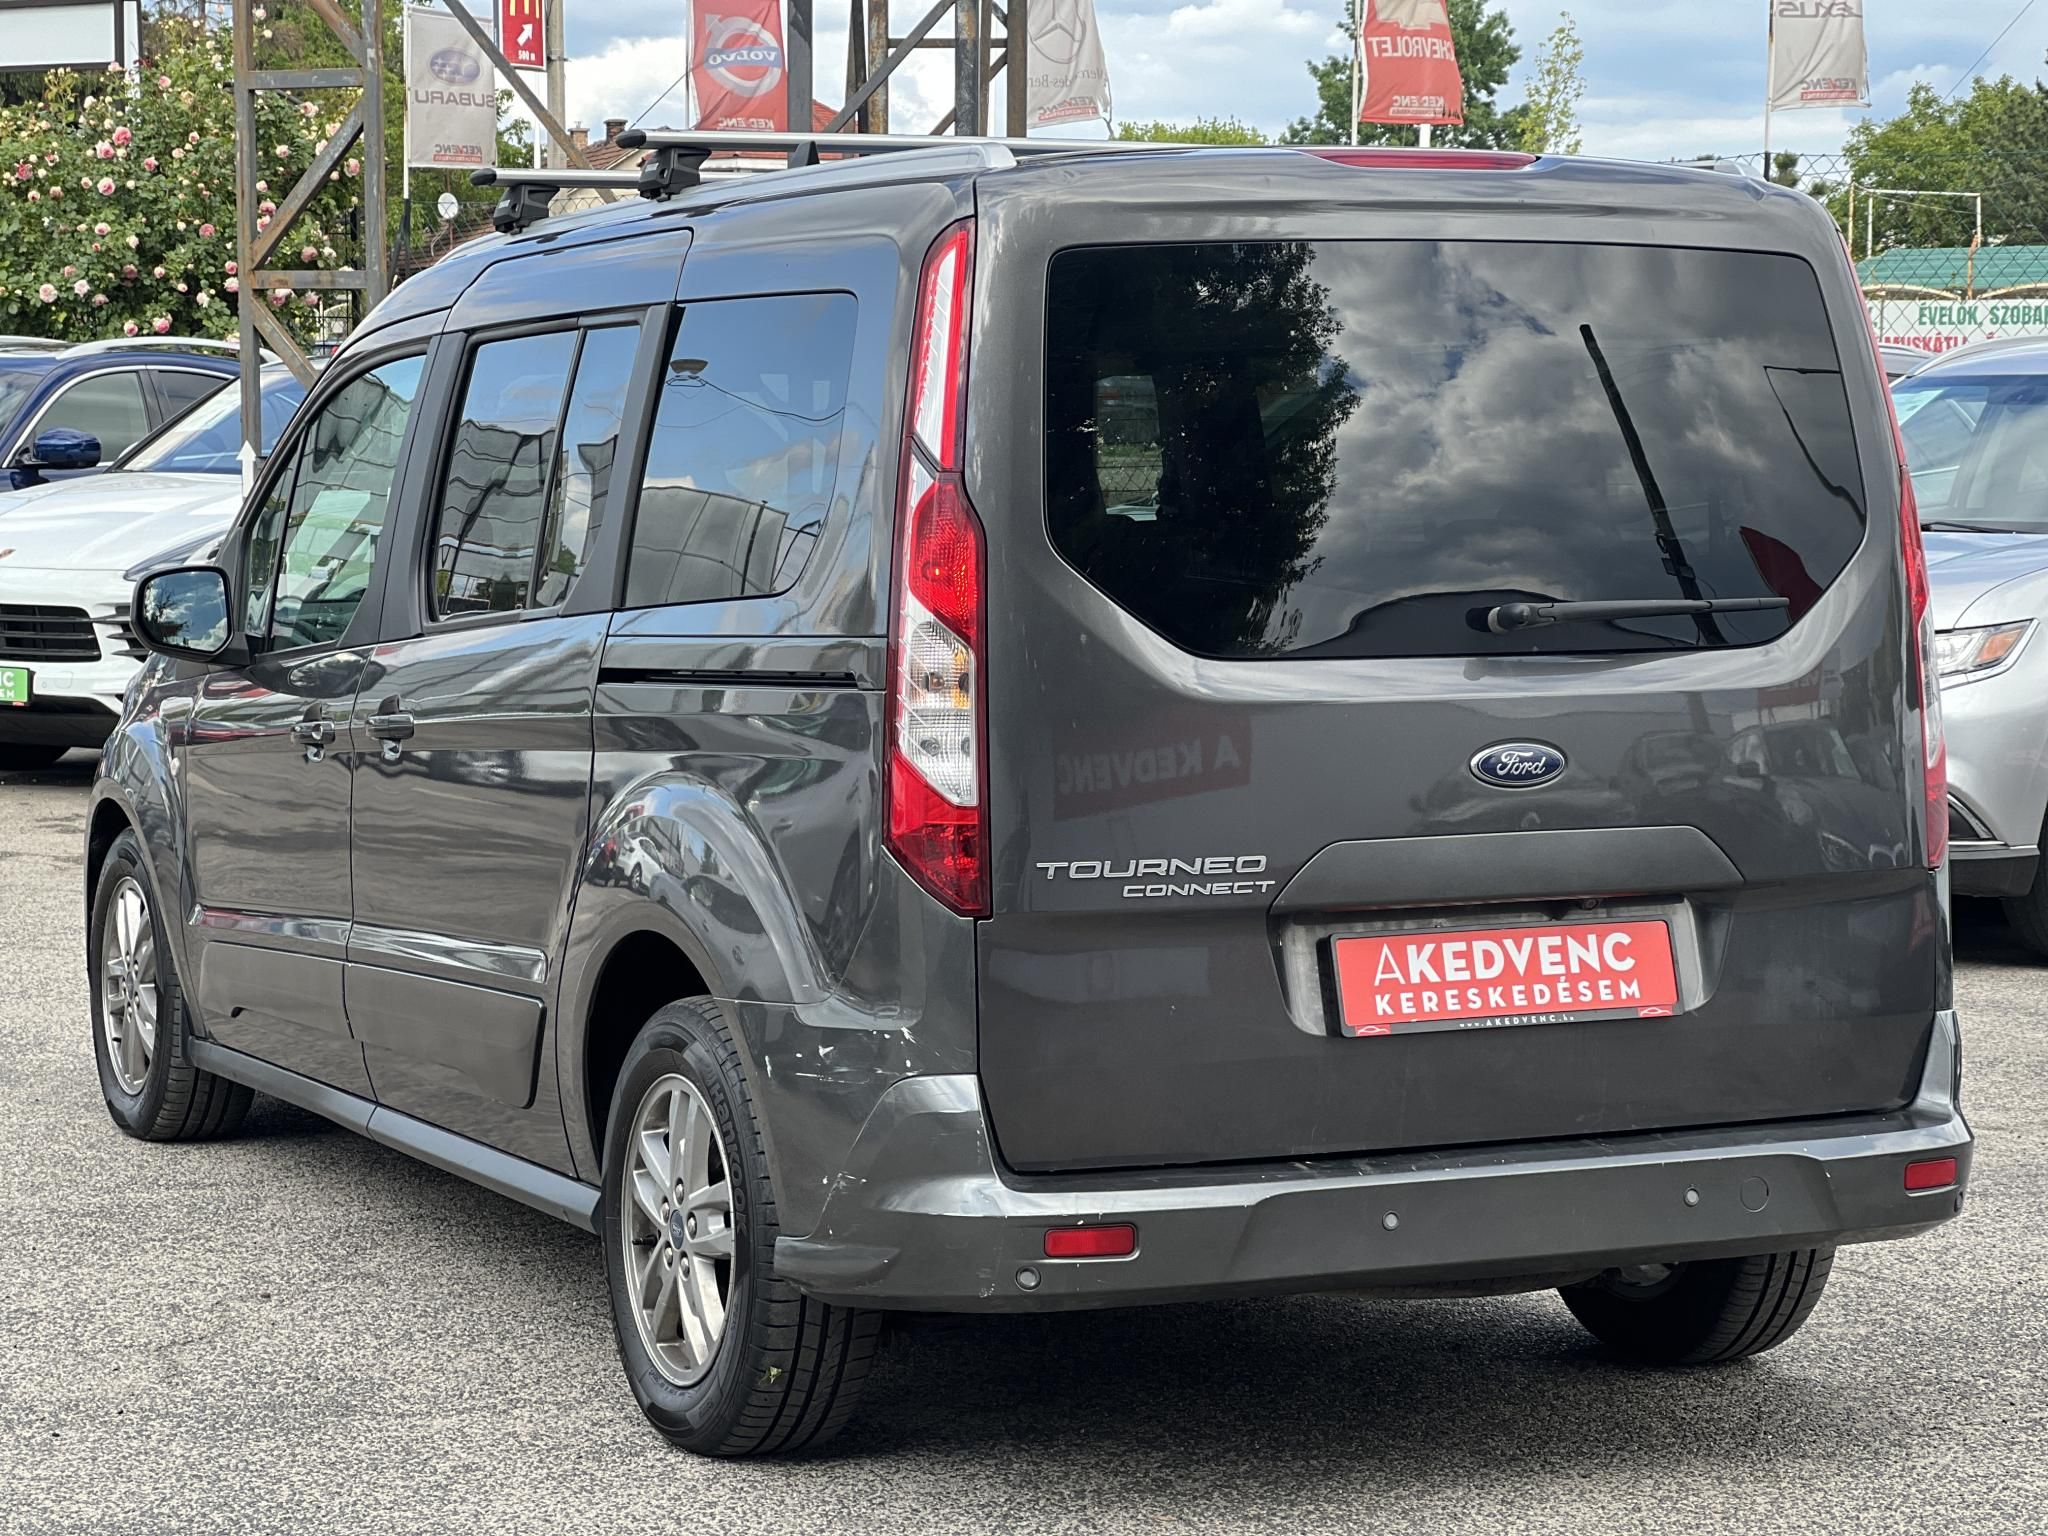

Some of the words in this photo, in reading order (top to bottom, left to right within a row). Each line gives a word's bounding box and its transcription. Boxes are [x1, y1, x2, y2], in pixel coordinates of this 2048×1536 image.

[1496, 750, 1546, 775] Ford
[1036, 855, 1267, 880] TOURNEO
[1122, 880, 1276, 898] CONNECT
[1375, 976, 1641, 1016] KERESKEDÉSEM
